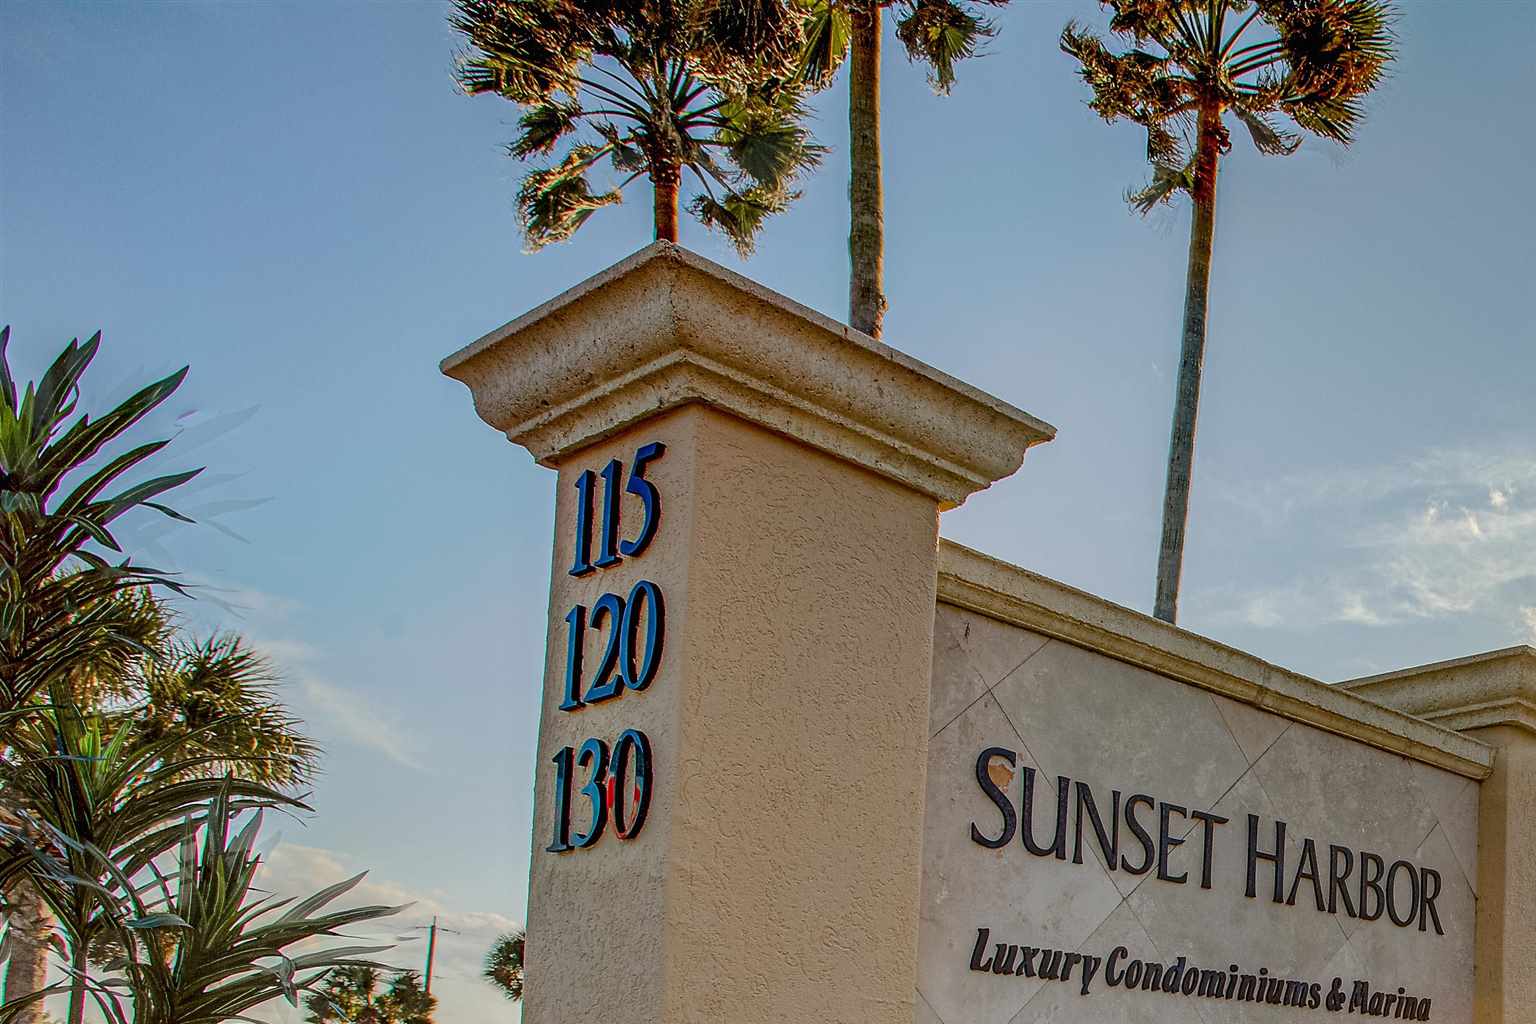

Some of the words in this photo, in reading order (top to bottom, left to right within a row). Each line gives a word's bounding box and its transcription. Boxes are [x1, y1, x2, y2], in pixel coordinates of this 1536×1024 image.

[569, 441, 666, 577] 115
[559, 579, 666, 712] 120
[545, 729, 654, 852] 130
[970, 746, 1230, 890] SUNSET
[1244, 813, 1446, 936] HARBOR
[969, 927, 1102, 996] Luxury
[1105, 946, 1322, 1010] Condominiums
[1324, 977, 1346, 1013] &
[1348, 979, 1433, 1023] Marina
